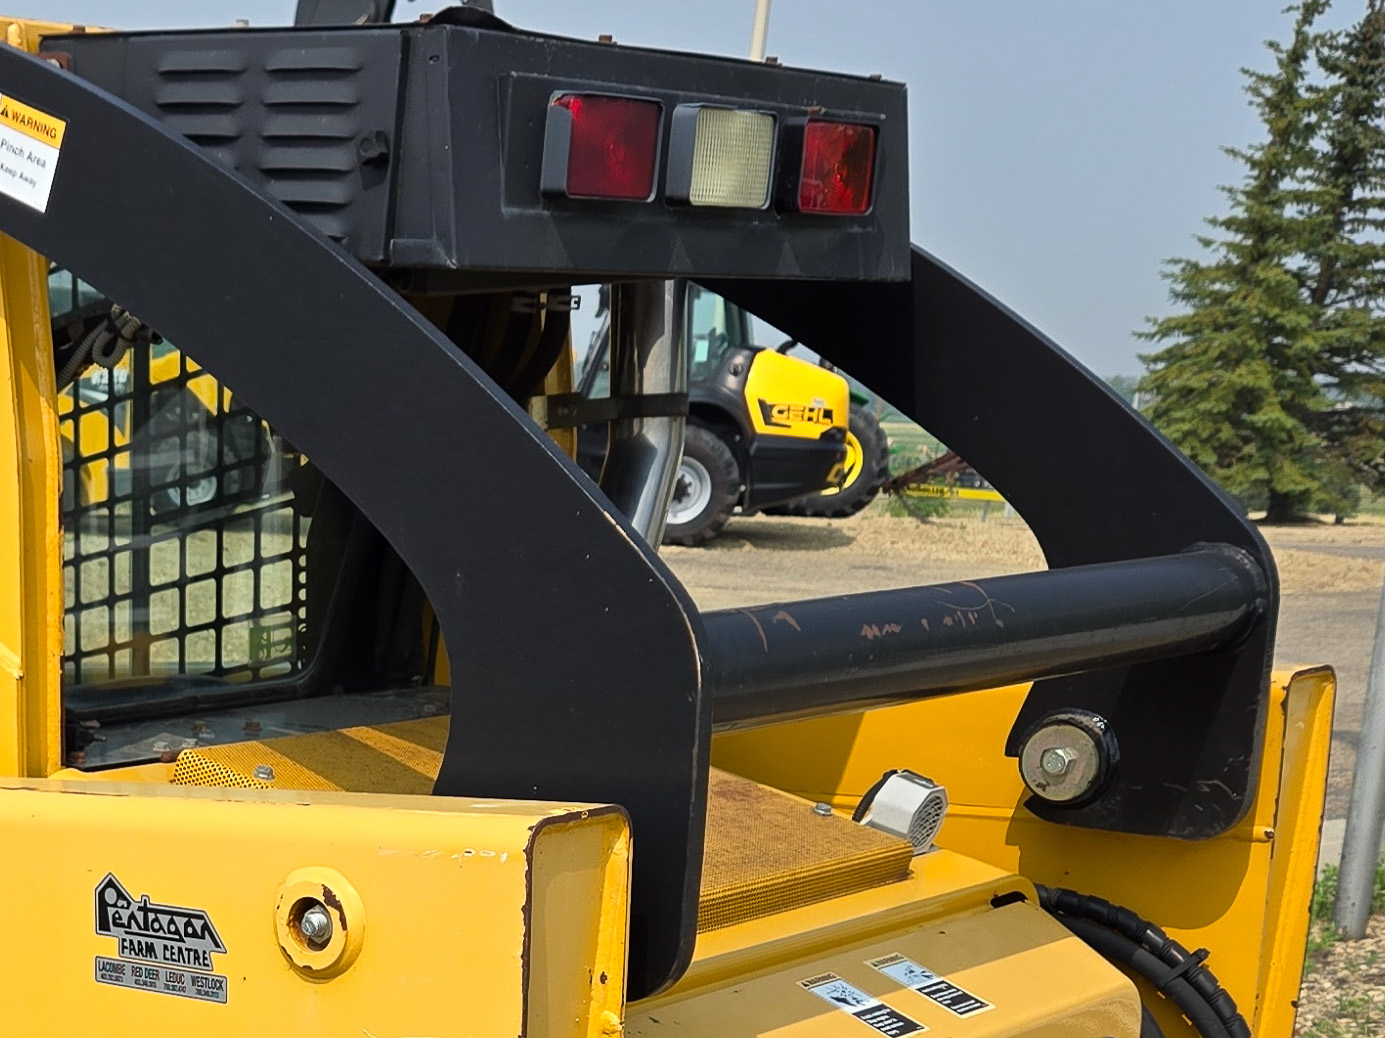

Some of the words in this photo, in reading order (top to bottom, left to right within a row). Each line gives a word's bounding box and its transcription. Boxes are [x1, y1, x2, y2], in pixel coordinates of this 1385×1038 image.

[12, 111, 57, 139] WARNING
[0, 138, 25, 159] Pinch
[27, 151, 47, 169] Area
[0, 162, 18, 178] Keep
[19, 171, 38, 189] Away
[771, 404, 833, 425] GEHL
[98, 877, 222, 949] Pentagon
[121, 938, 158, 959] FARM
[163, 944, 210, 967] CENTRE
[131, 965, 143, 978] RED
[144, 967, 160, 981] DEER
[165, 971, 185, 985] LEDUC
[190, 975, 224, 992] WESTLOCK
